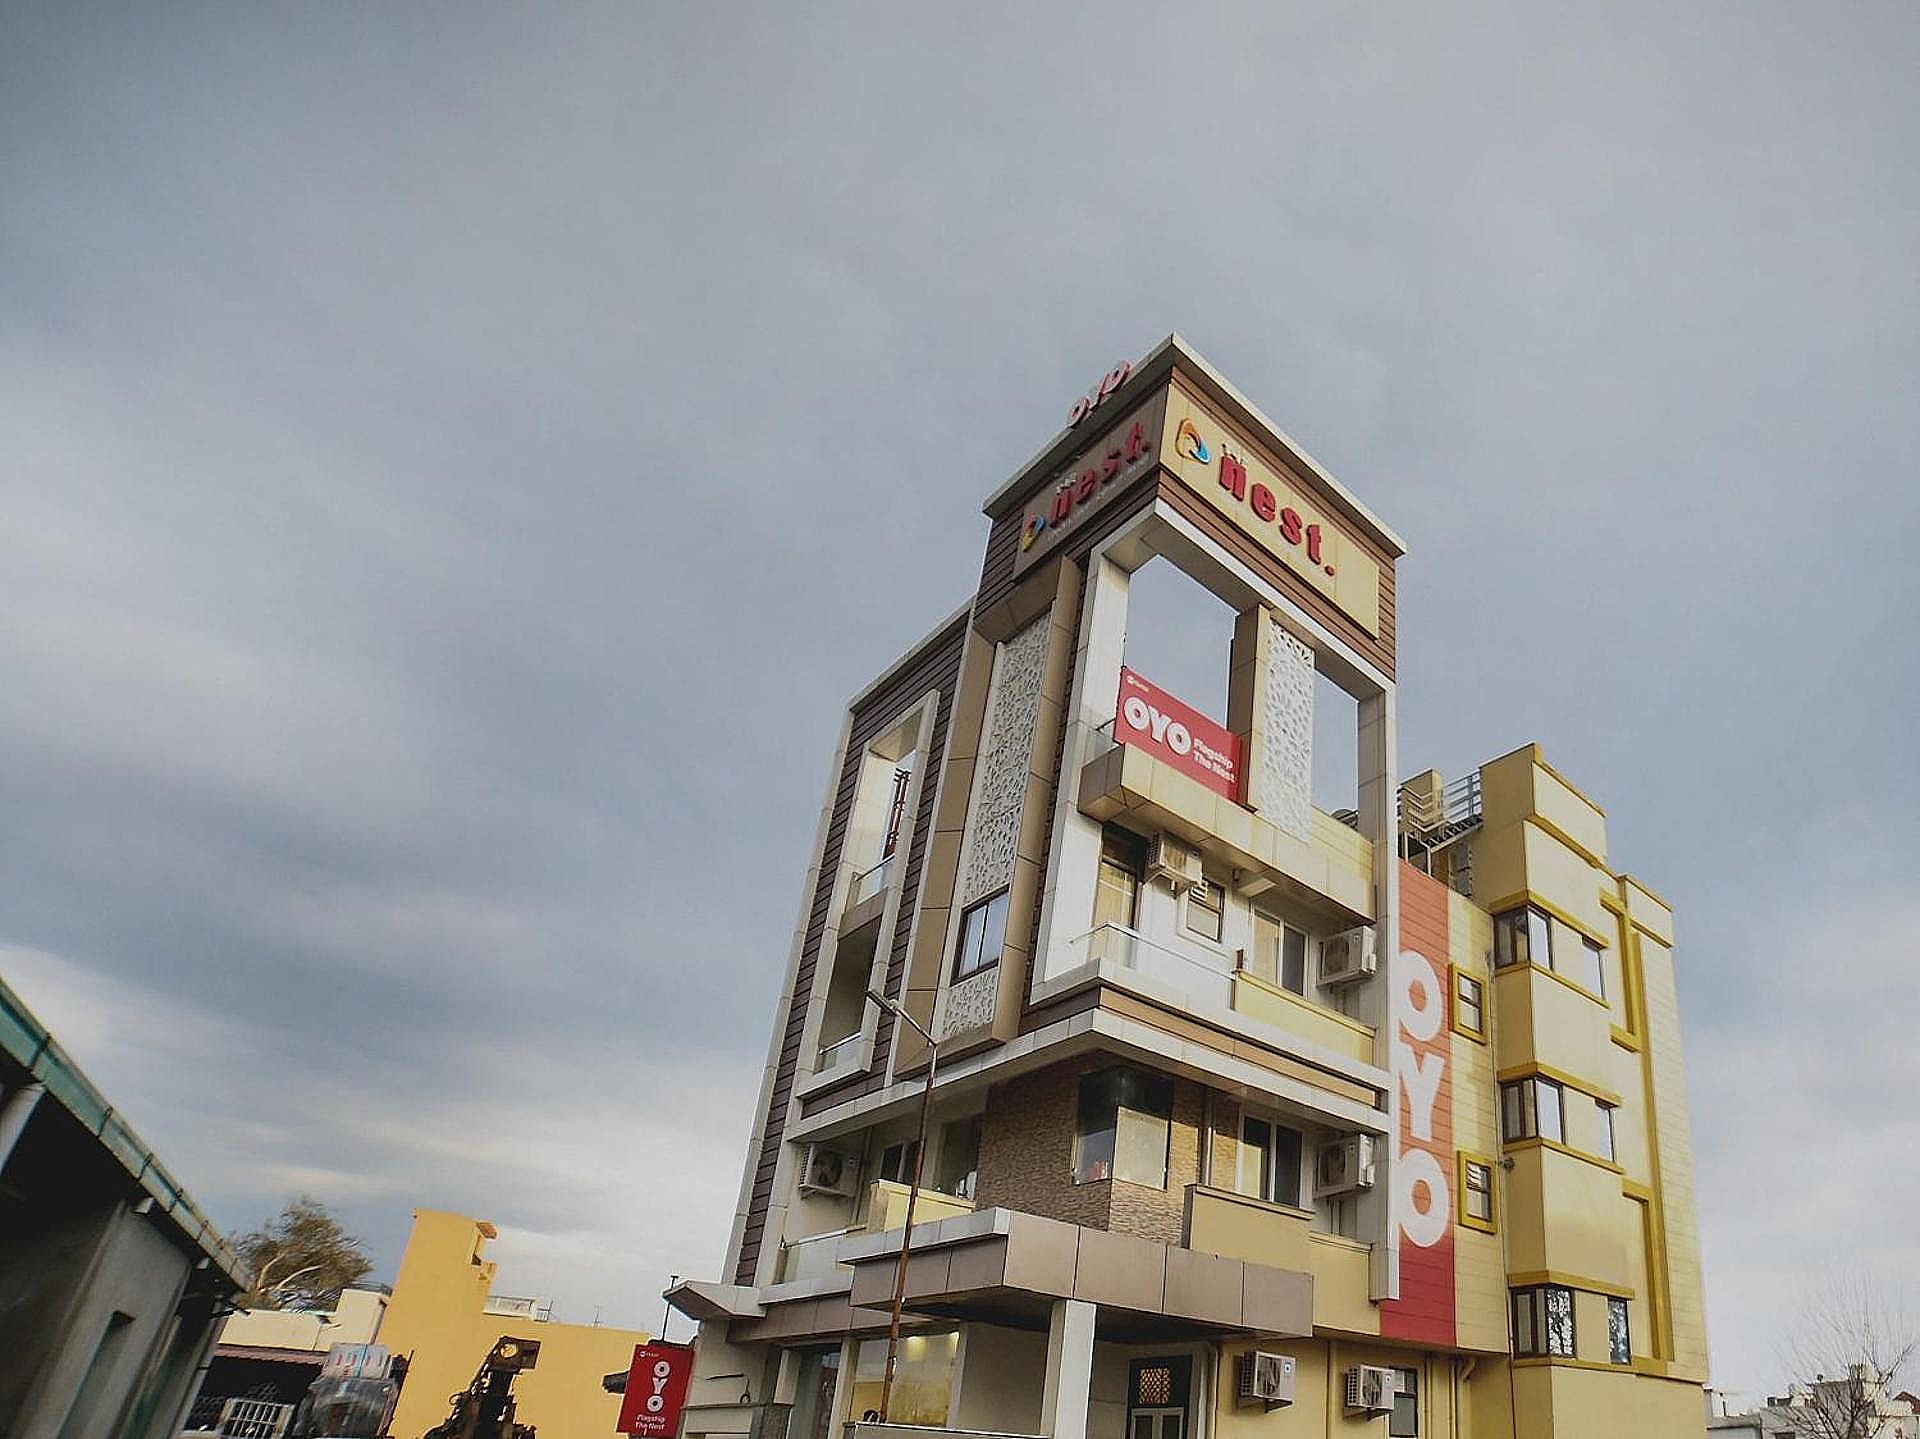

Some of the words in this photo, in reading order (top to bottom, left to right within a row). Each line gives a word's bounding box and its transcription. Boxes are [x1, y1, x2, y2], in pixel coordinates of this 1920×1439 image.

[1065, 360, 1132, 430] OYO
[1123, 696, 1192, 756] OYO
[1193, 737, 1234, 770] Flagship
[1192, 750, 1212, 770] The
[1399, 950, 1449, 1248] OYO
[647, 1361, 671, 1413] OYO
